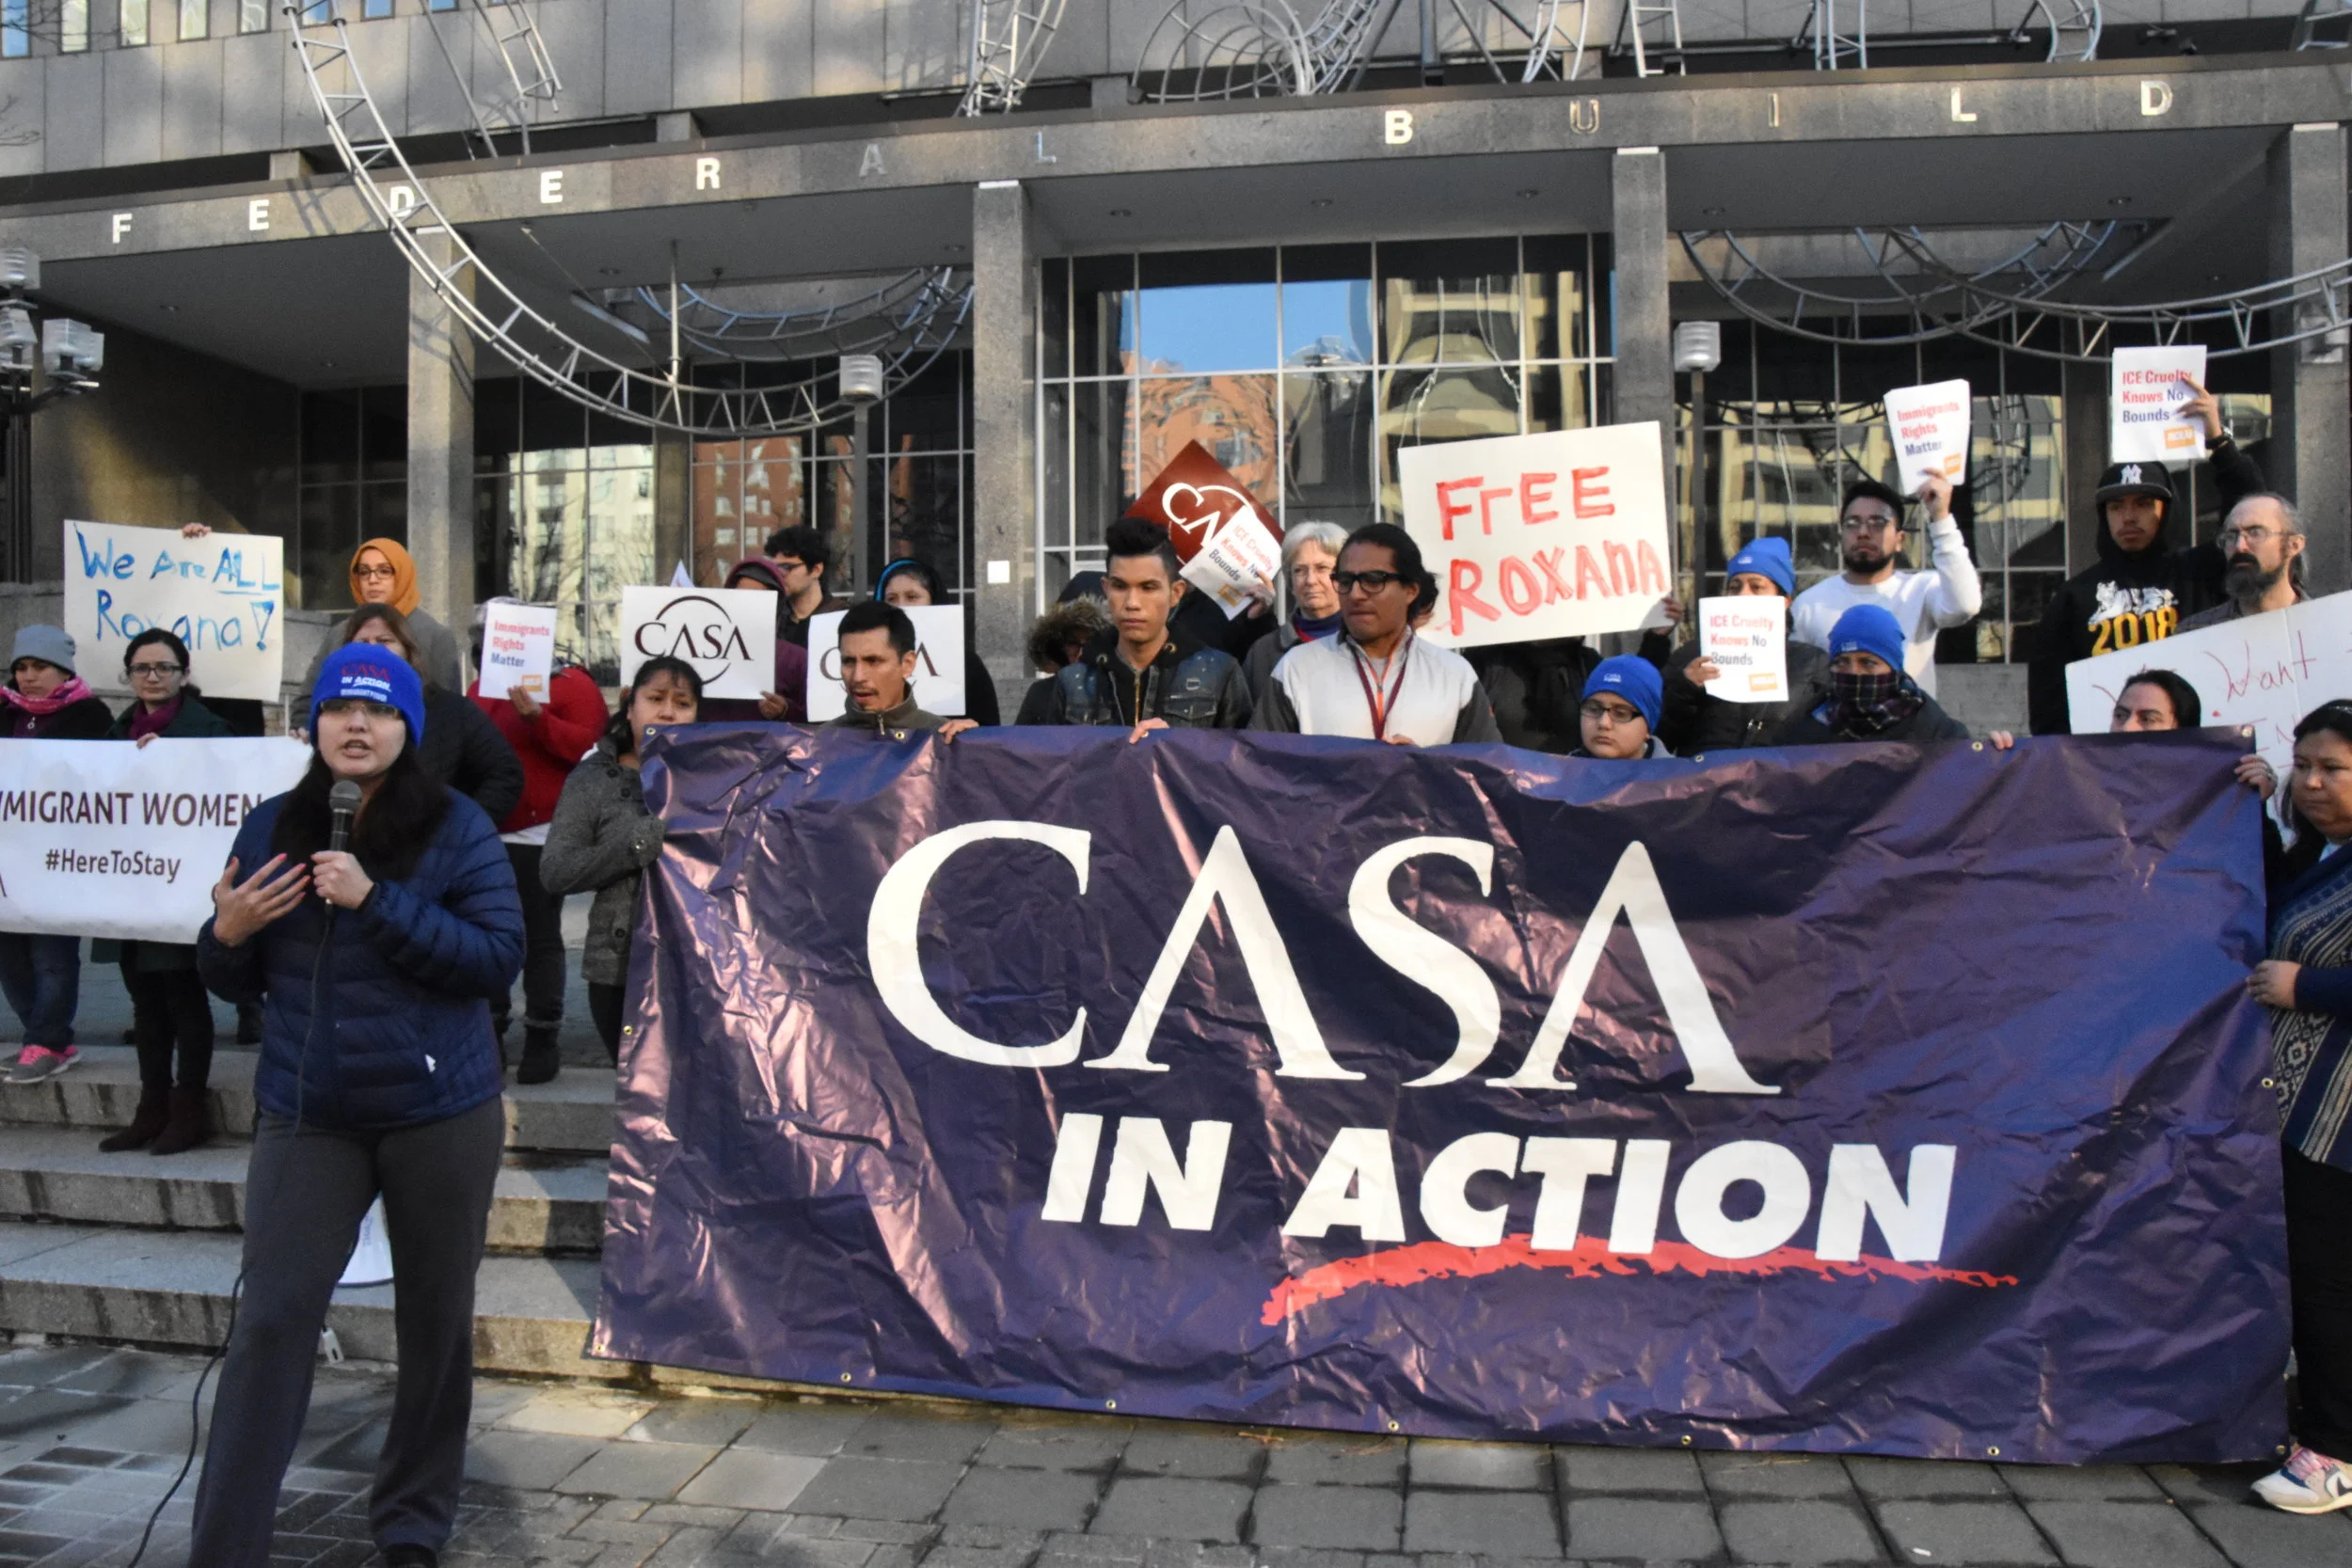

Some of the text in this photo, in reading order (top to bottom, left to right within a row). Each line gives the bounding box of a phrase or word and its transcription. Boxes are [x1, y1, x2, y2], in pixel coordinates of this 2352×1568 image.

[112, 80, 2173, 244] FEDERAL BUILD
[2122, 369, 2193, 385] ICE Cruelty
[2122, 388, 2185, 404] Knows No
[1897, 402, 1960, 422] Immigrants
[2122, 407, 2170, 423] Bounds
[1901, 423, 1938, 440] Rights
[1904, 441, 1943, 457] Matter
[1162, 483, 1221, 548] CA
[74, 522, 280, 591] We Are ALL
[1221, 537, 1249, 568] Knows
[1209, 548, 1242, 582] Bounds
[494, 620, 550, 639] Immigrants
[1709, 614, 1773, 631] ICE Cruelty
[2088, 606, 2179, 657] 2018
[492, 636, 525, 652] Rights
[634, 622, 755, 661] CASA
[1710, 632, 1767, 647] Knows No
[490, 652, 525, 668] Matter
[1711, 651, 1753, 666] Bounds
[0, 790, 135, 825] MIGRANT
[45, 848, 182, 884] #HereToStay
[866, 819, 1782, 1095] CASA
[1041, 1112, 1957, 1262] IN ACTION
